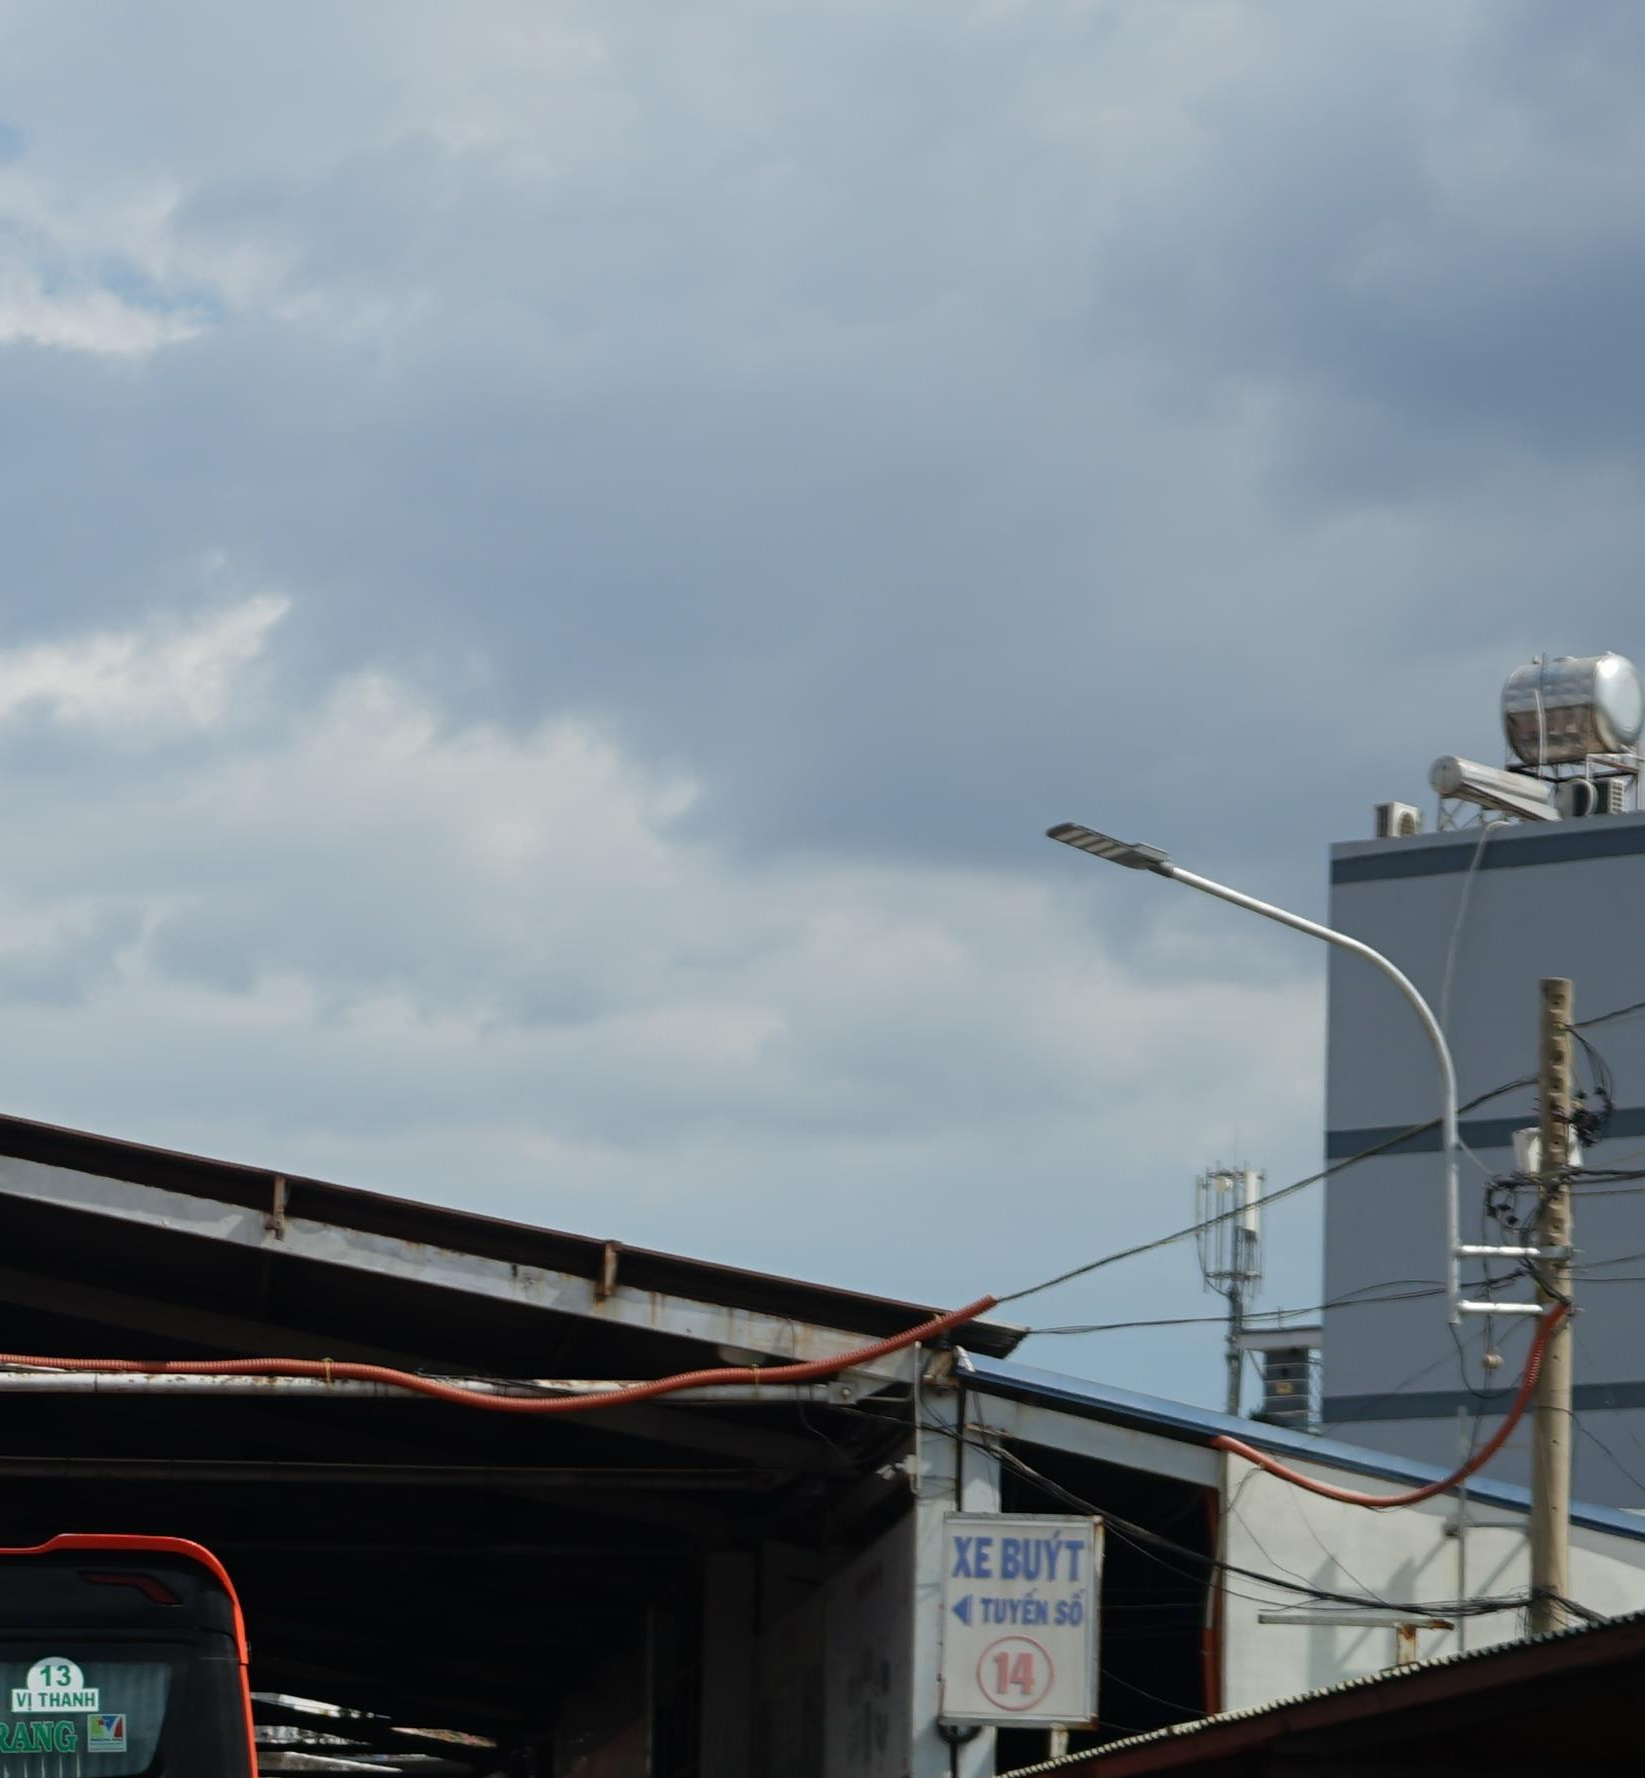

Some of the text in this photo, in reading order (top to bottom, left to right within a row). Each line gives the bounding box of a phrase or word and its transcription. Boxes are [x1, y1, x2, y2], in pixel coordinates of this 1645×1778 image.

[952, 1530, 1086, 1582] XE BUÝT
[979, 1587, 1086, 1627] TUYẾN SỐ
[39, 1664, 72, 1687] 13
[992, 1651, 1034, 1696] 14
[38, 1692, 96, 1708] THANH
